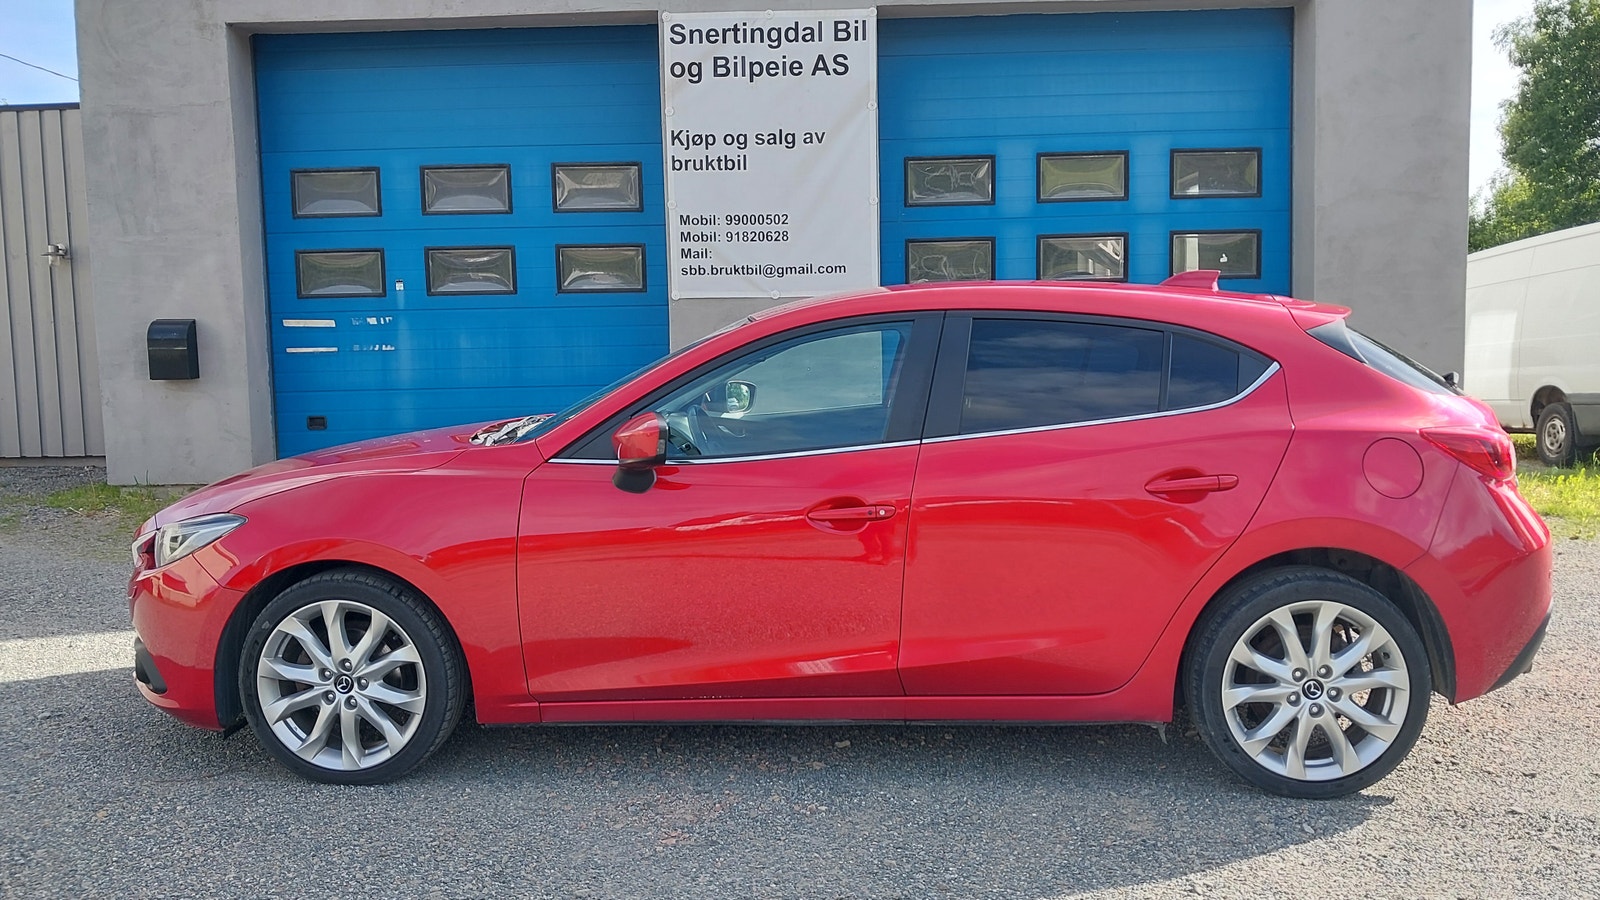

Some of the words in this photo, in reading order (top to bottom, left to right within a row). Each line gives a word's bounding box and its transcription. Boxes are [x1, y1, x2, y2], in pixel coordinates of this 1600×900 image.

[670, 21, 822, 49] Snertingdal
[834, 20, 866, 41] Bil
[670, 62, 702, 84] og
[713, 55, 803, 83] Bilpeie
[811, 54, 849, 76] AS
[671, 130, 716, 150] Kjøp
[723, 134, 747, 150] og
[755, 129, 795, 149] salg
[803, 132, 825, 144] av
[672, 154, 746, 171] bruktbil
[680, 215, 720, 226] Mobil:
[726, 214, 788, 225] 99000502
[681, 231, 720, 242] Mobil:
[726, 231, 788, 242] 91820628
[681, 248, 712, 259] Mail:
[681, 263, 846, 278] sbb.bruktbil@gmail.com
